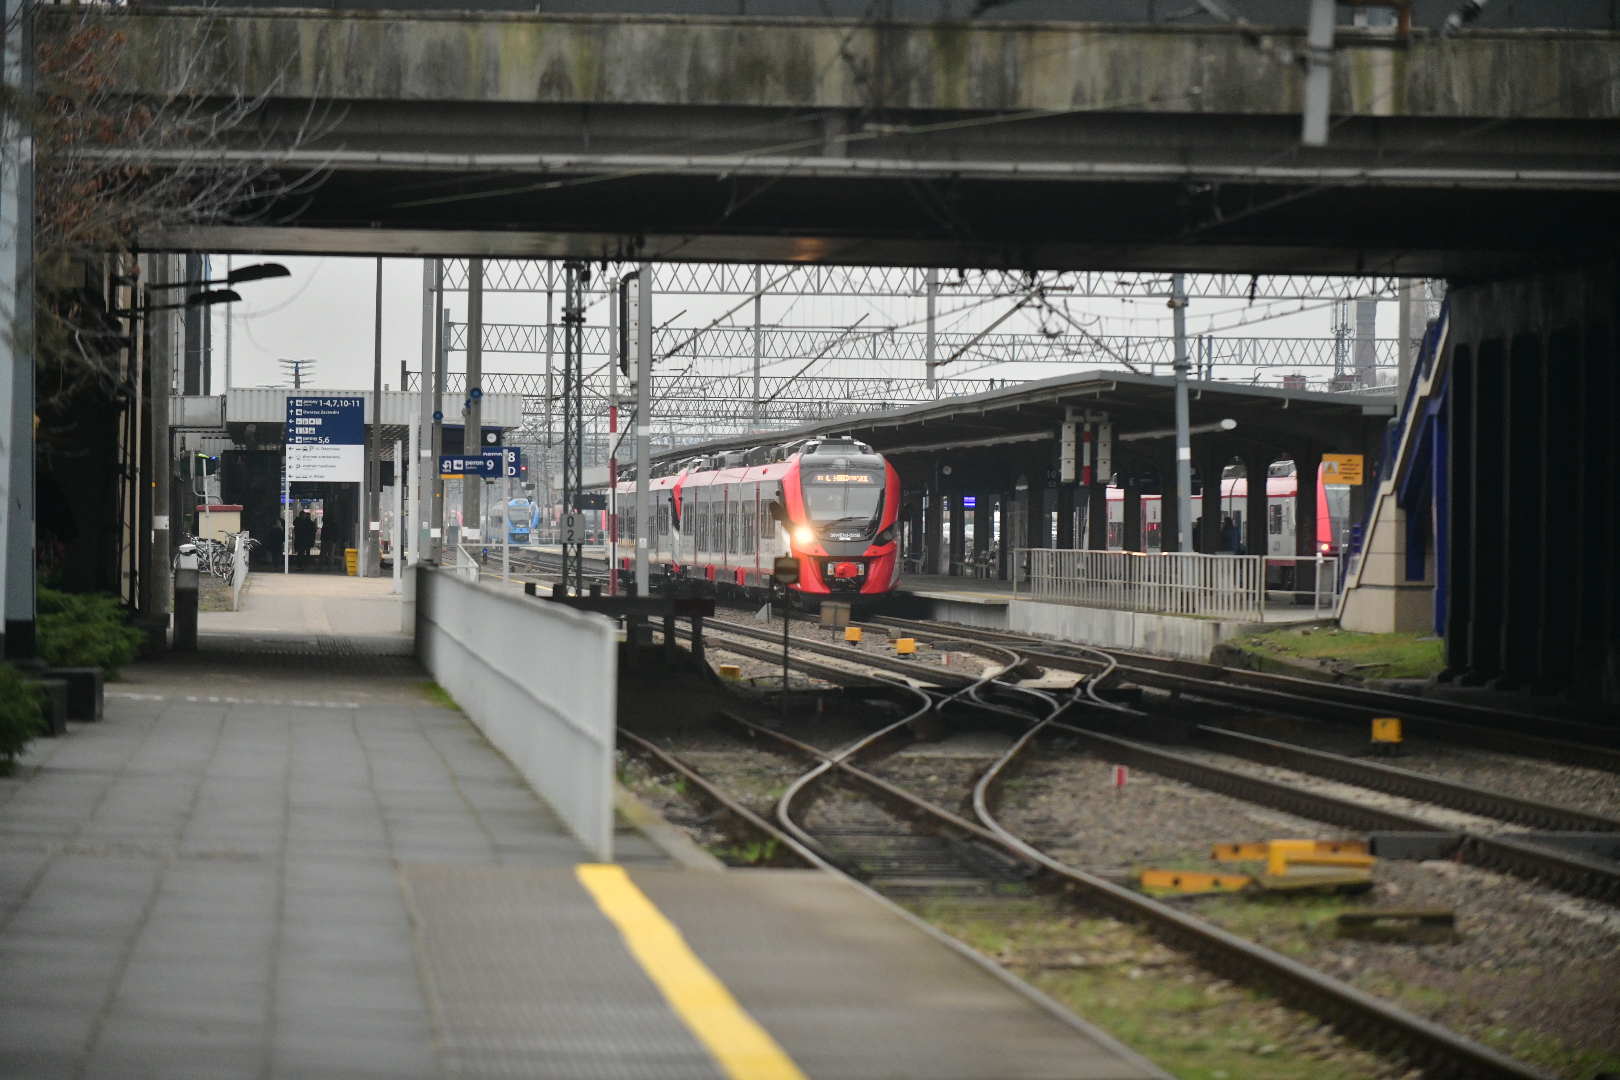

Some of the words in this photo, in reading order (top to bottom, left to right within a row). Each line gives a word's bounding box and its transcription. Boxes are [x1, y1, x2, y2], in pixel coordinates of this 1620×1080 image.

[508, 452, 516, 462] 8
[486, 460, 494, 470] 9
[508, 466, 516, 475] D
